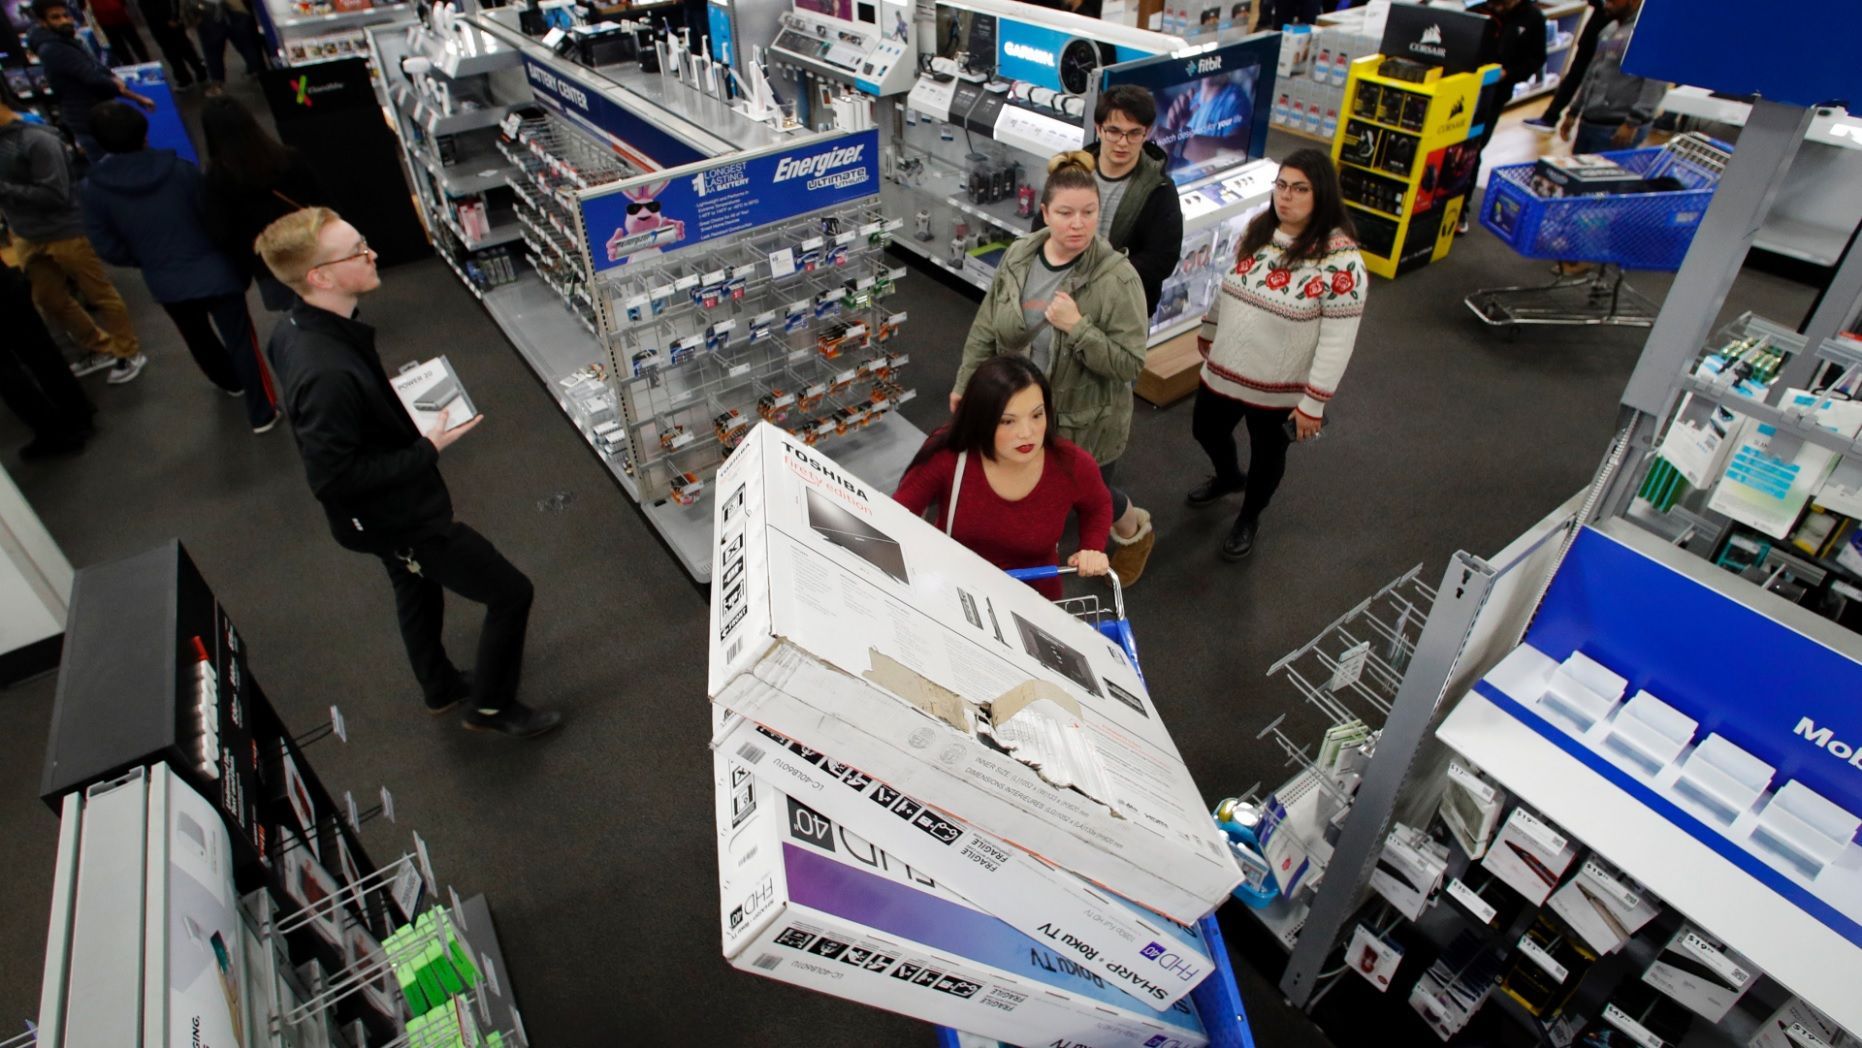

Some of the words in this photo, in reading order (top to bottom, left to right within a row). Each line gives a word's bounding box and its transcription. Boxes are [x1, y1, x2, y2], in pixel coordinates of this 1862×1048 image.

[1004, 41, 1055, 67] GARMIN
[1409, 42, 1446, 57] CORSAIR
[1198, 56, 1222, 73] fitbit
[527, 61, 558, 92] BATTERY
[557, 79, 589, 111] CENTER
[704, 162, 747, 179] LONGEST
[773, 144, 863, 183] Energizer
[705, 172, 745, 188] LASTING
[781, 441, 869, 502] TOSHIBA
[826, 483, 873, 516] edition
[728, 607, 748, 630] FRONT
[961, 847, 998, 872] FRAGILE
[971, 838, 1008, 863] FRAGILE
[1037, 923, 1061, 940] TV
[1030, 948, 1057, 973] TV
[1158, 953, 1200, 982] FHD
[1106, 963, 1169, 1000] SHARP
[980, 997, 1015, 1011] FRAGILE
[990, 988, 1025, 1004] FRAGILE
